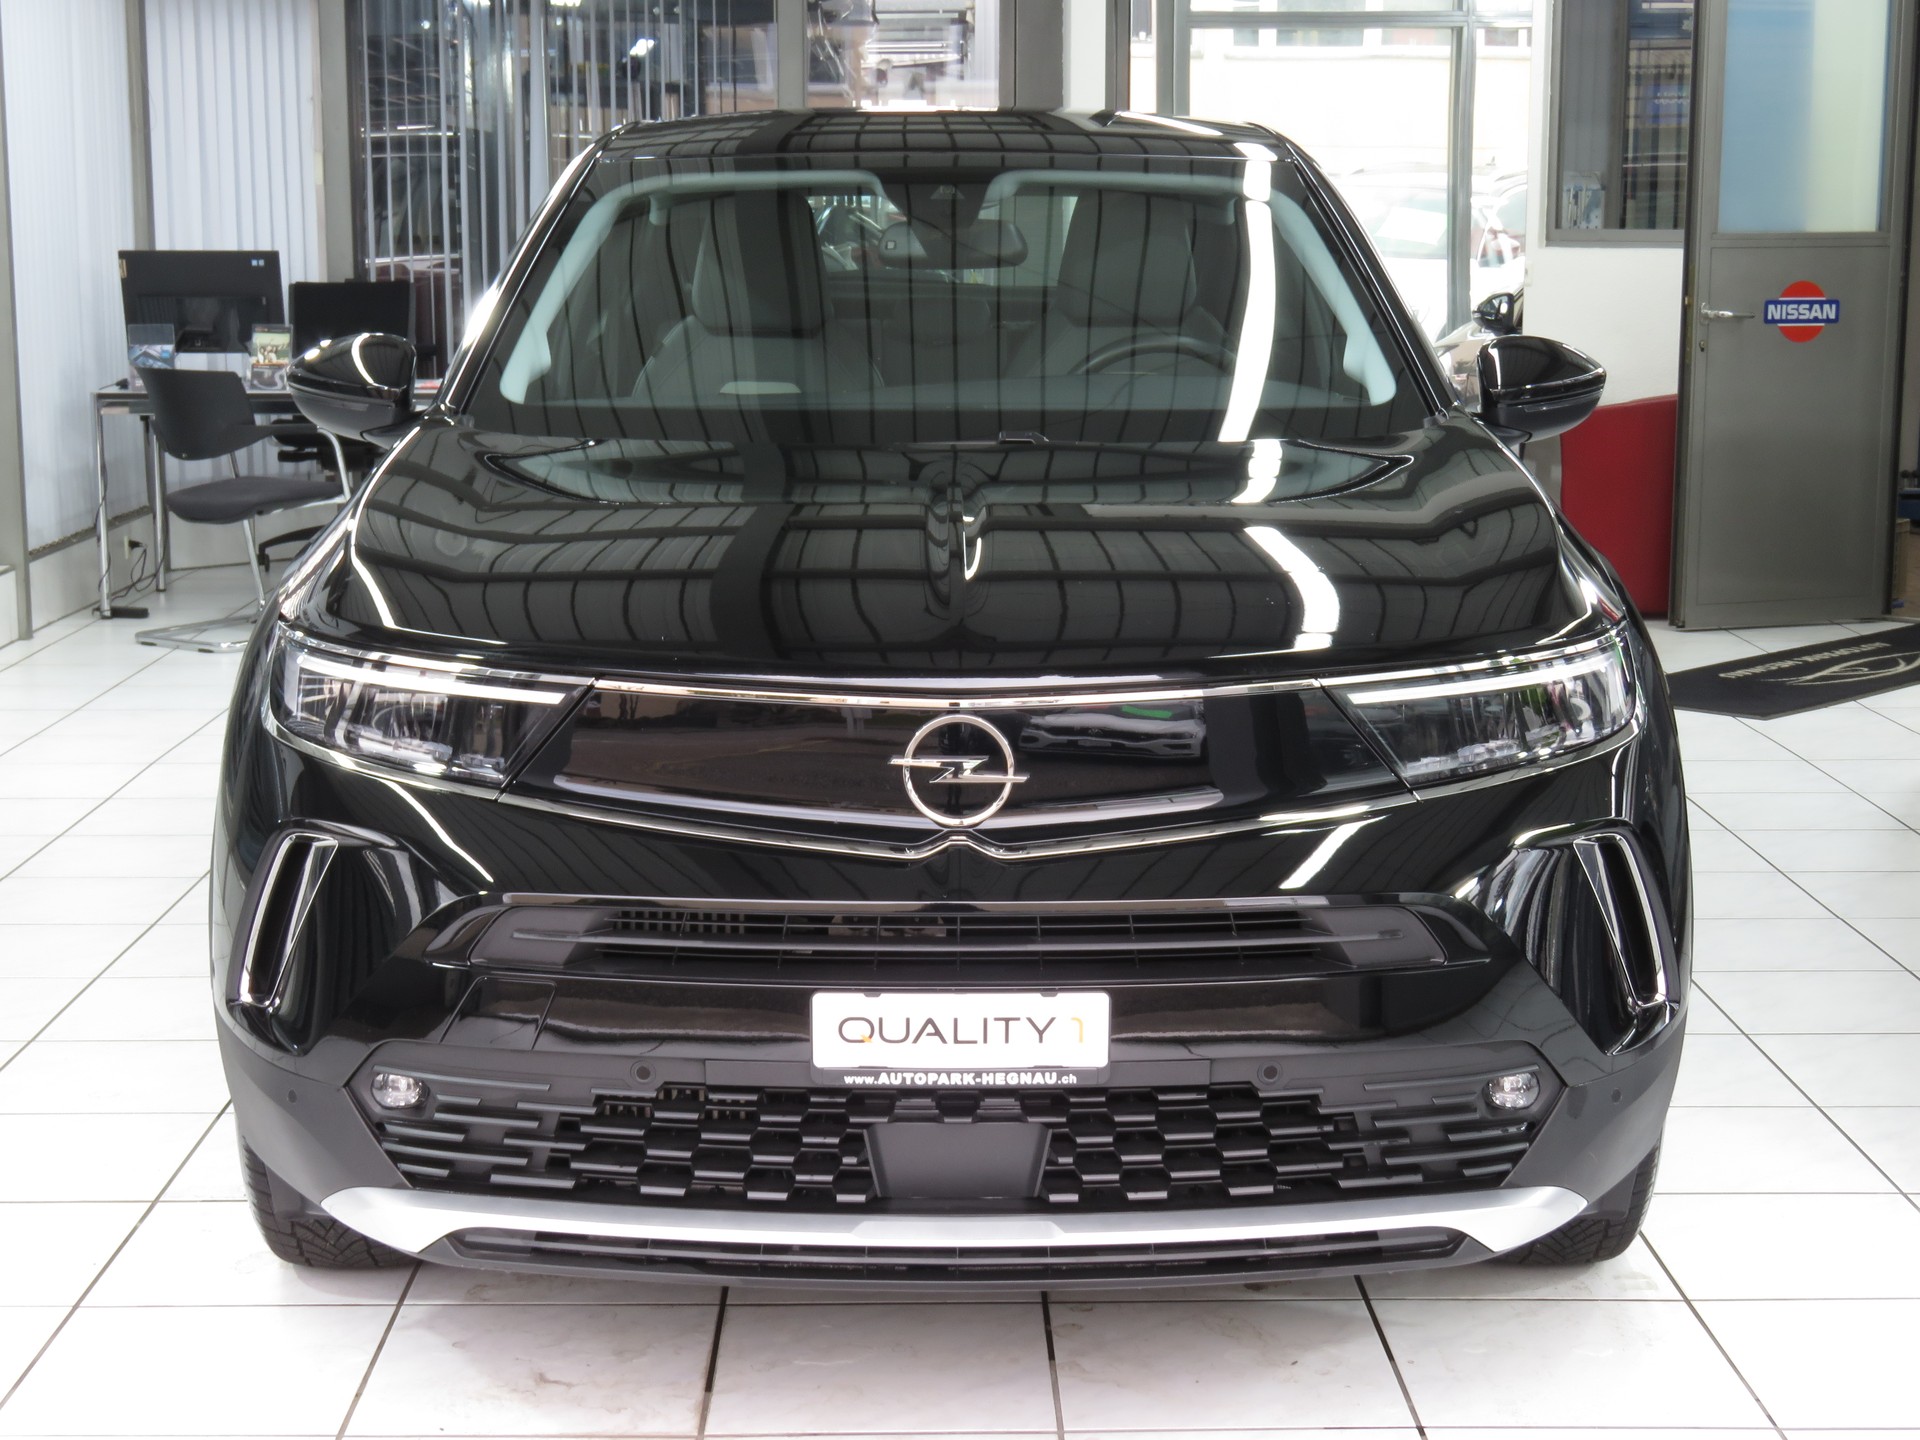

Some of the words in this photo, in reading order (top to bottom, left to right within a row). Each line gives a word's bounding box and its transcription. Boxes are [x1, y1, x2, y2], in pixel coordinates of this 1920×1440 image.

[1767, 304, 1836, 320] NISSAN
[838, 1017, 1056, 1044] QUALITY
[1071, 1016, 1084, 1043] 1
[843, 1072, 1077, 1086] www.AUTOPARK-HEGNAU.ch
